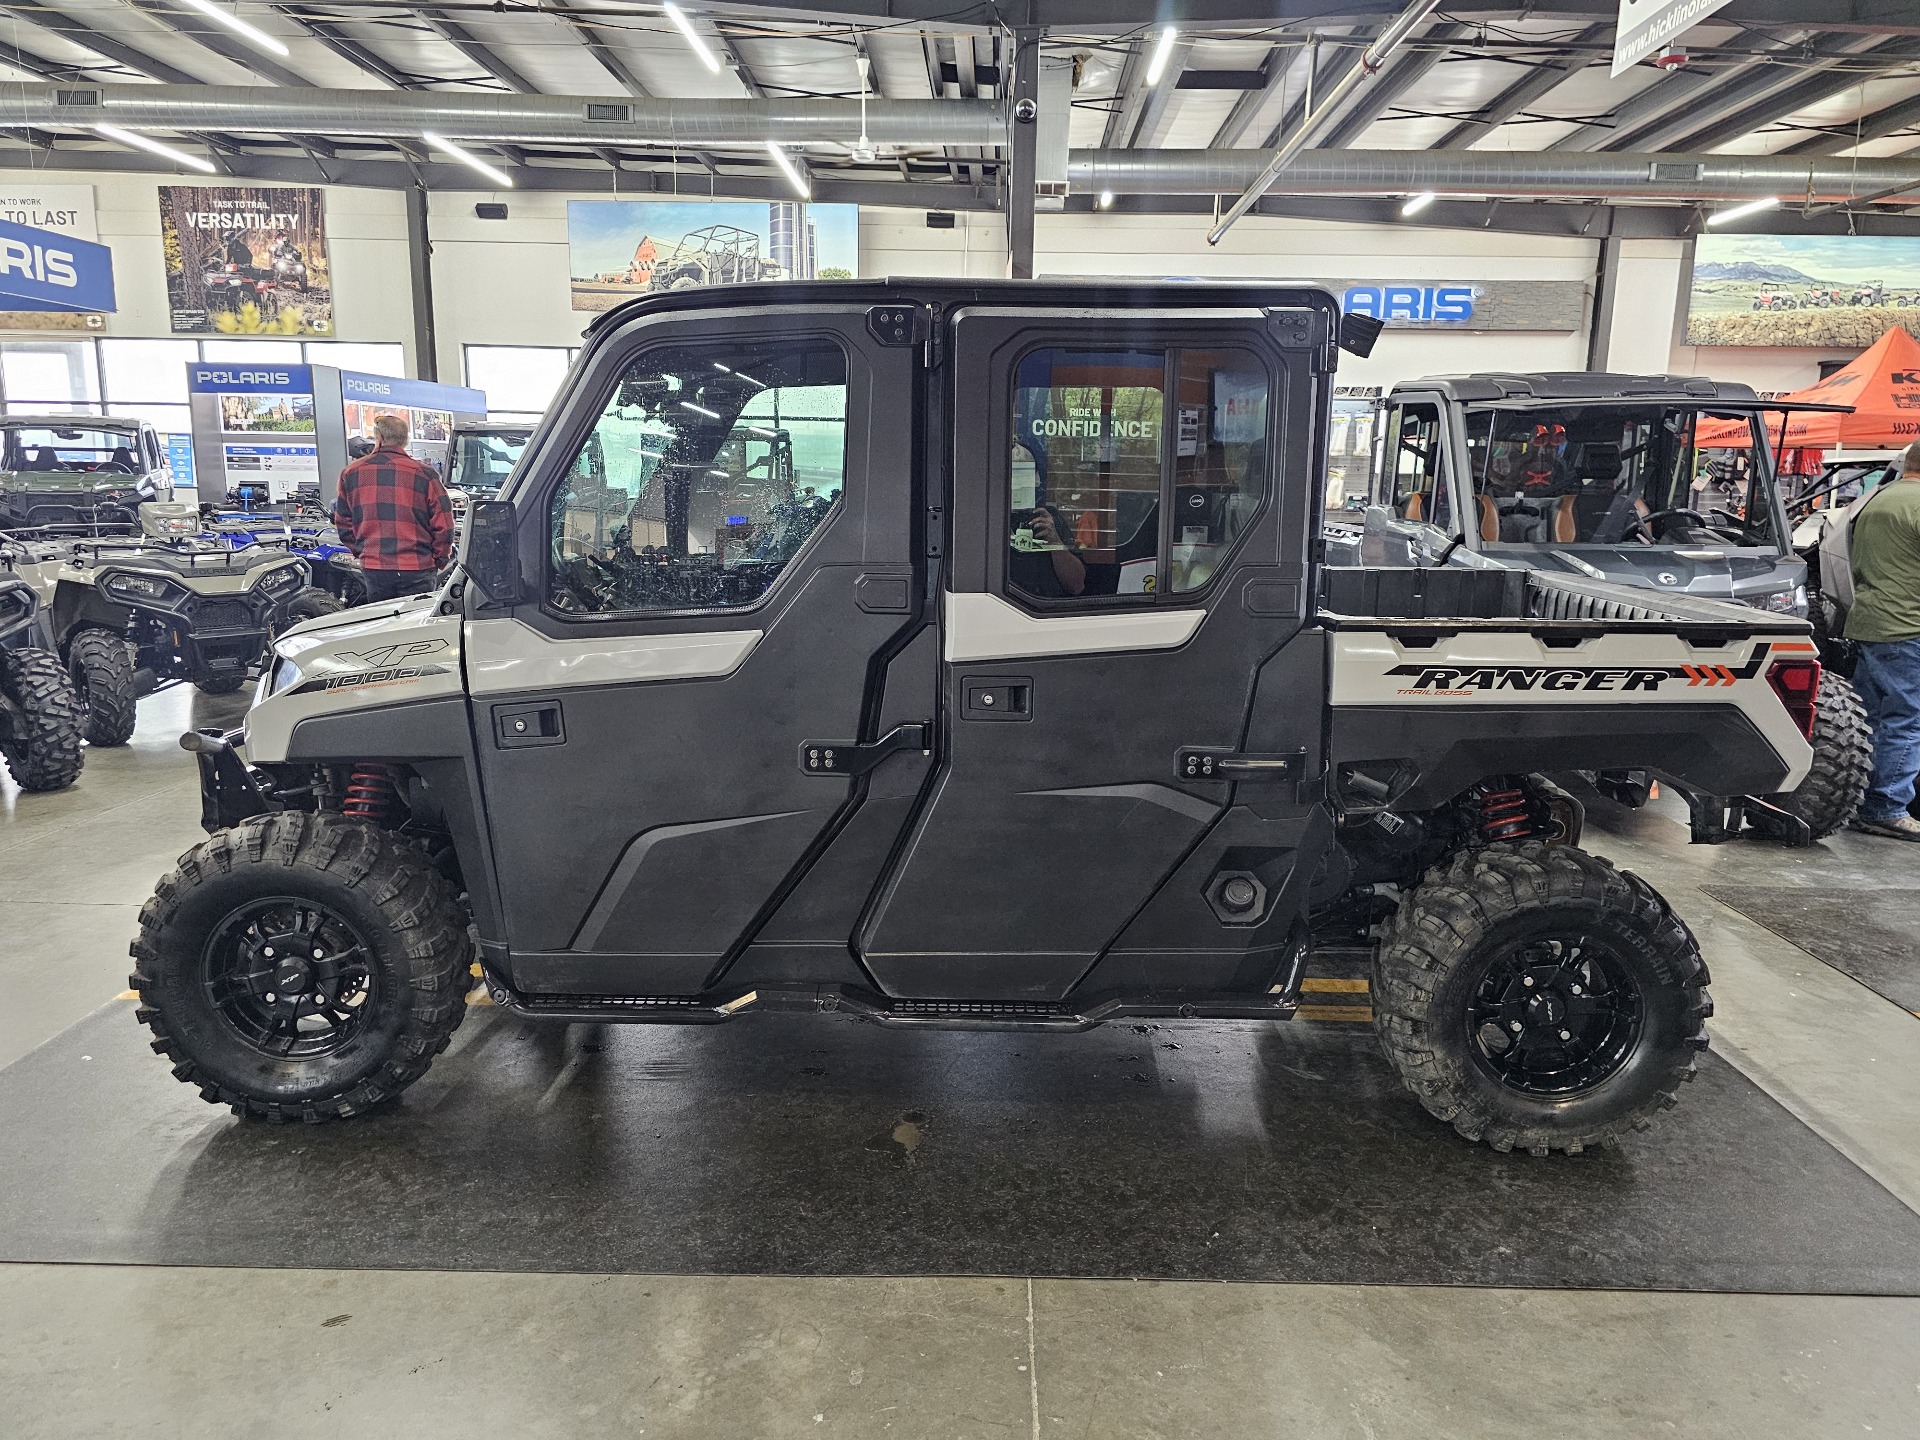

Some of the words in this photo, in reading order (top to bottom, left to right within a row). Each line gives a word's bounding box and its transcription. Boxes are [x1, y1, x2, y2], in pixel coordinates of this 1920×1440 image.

[5, 211, 27, 226] TO
[33, 211, 78, 226] LAST
[185, 212, 299, 230] VERSATILITY
[196, 371, 290, 385] POLARIS
[347, 379, 390, 395] POLARIS
[1069, 408, 1090, 417] RIDE
[1092, 408, 1117, 417] WH
[1032, 420, 1153, 438] CONFIDNCE
[334, 639, 449, 668] XP
[325, 666, 422, 689] 1000
[1412, 668, 1673, 691] RANGER
